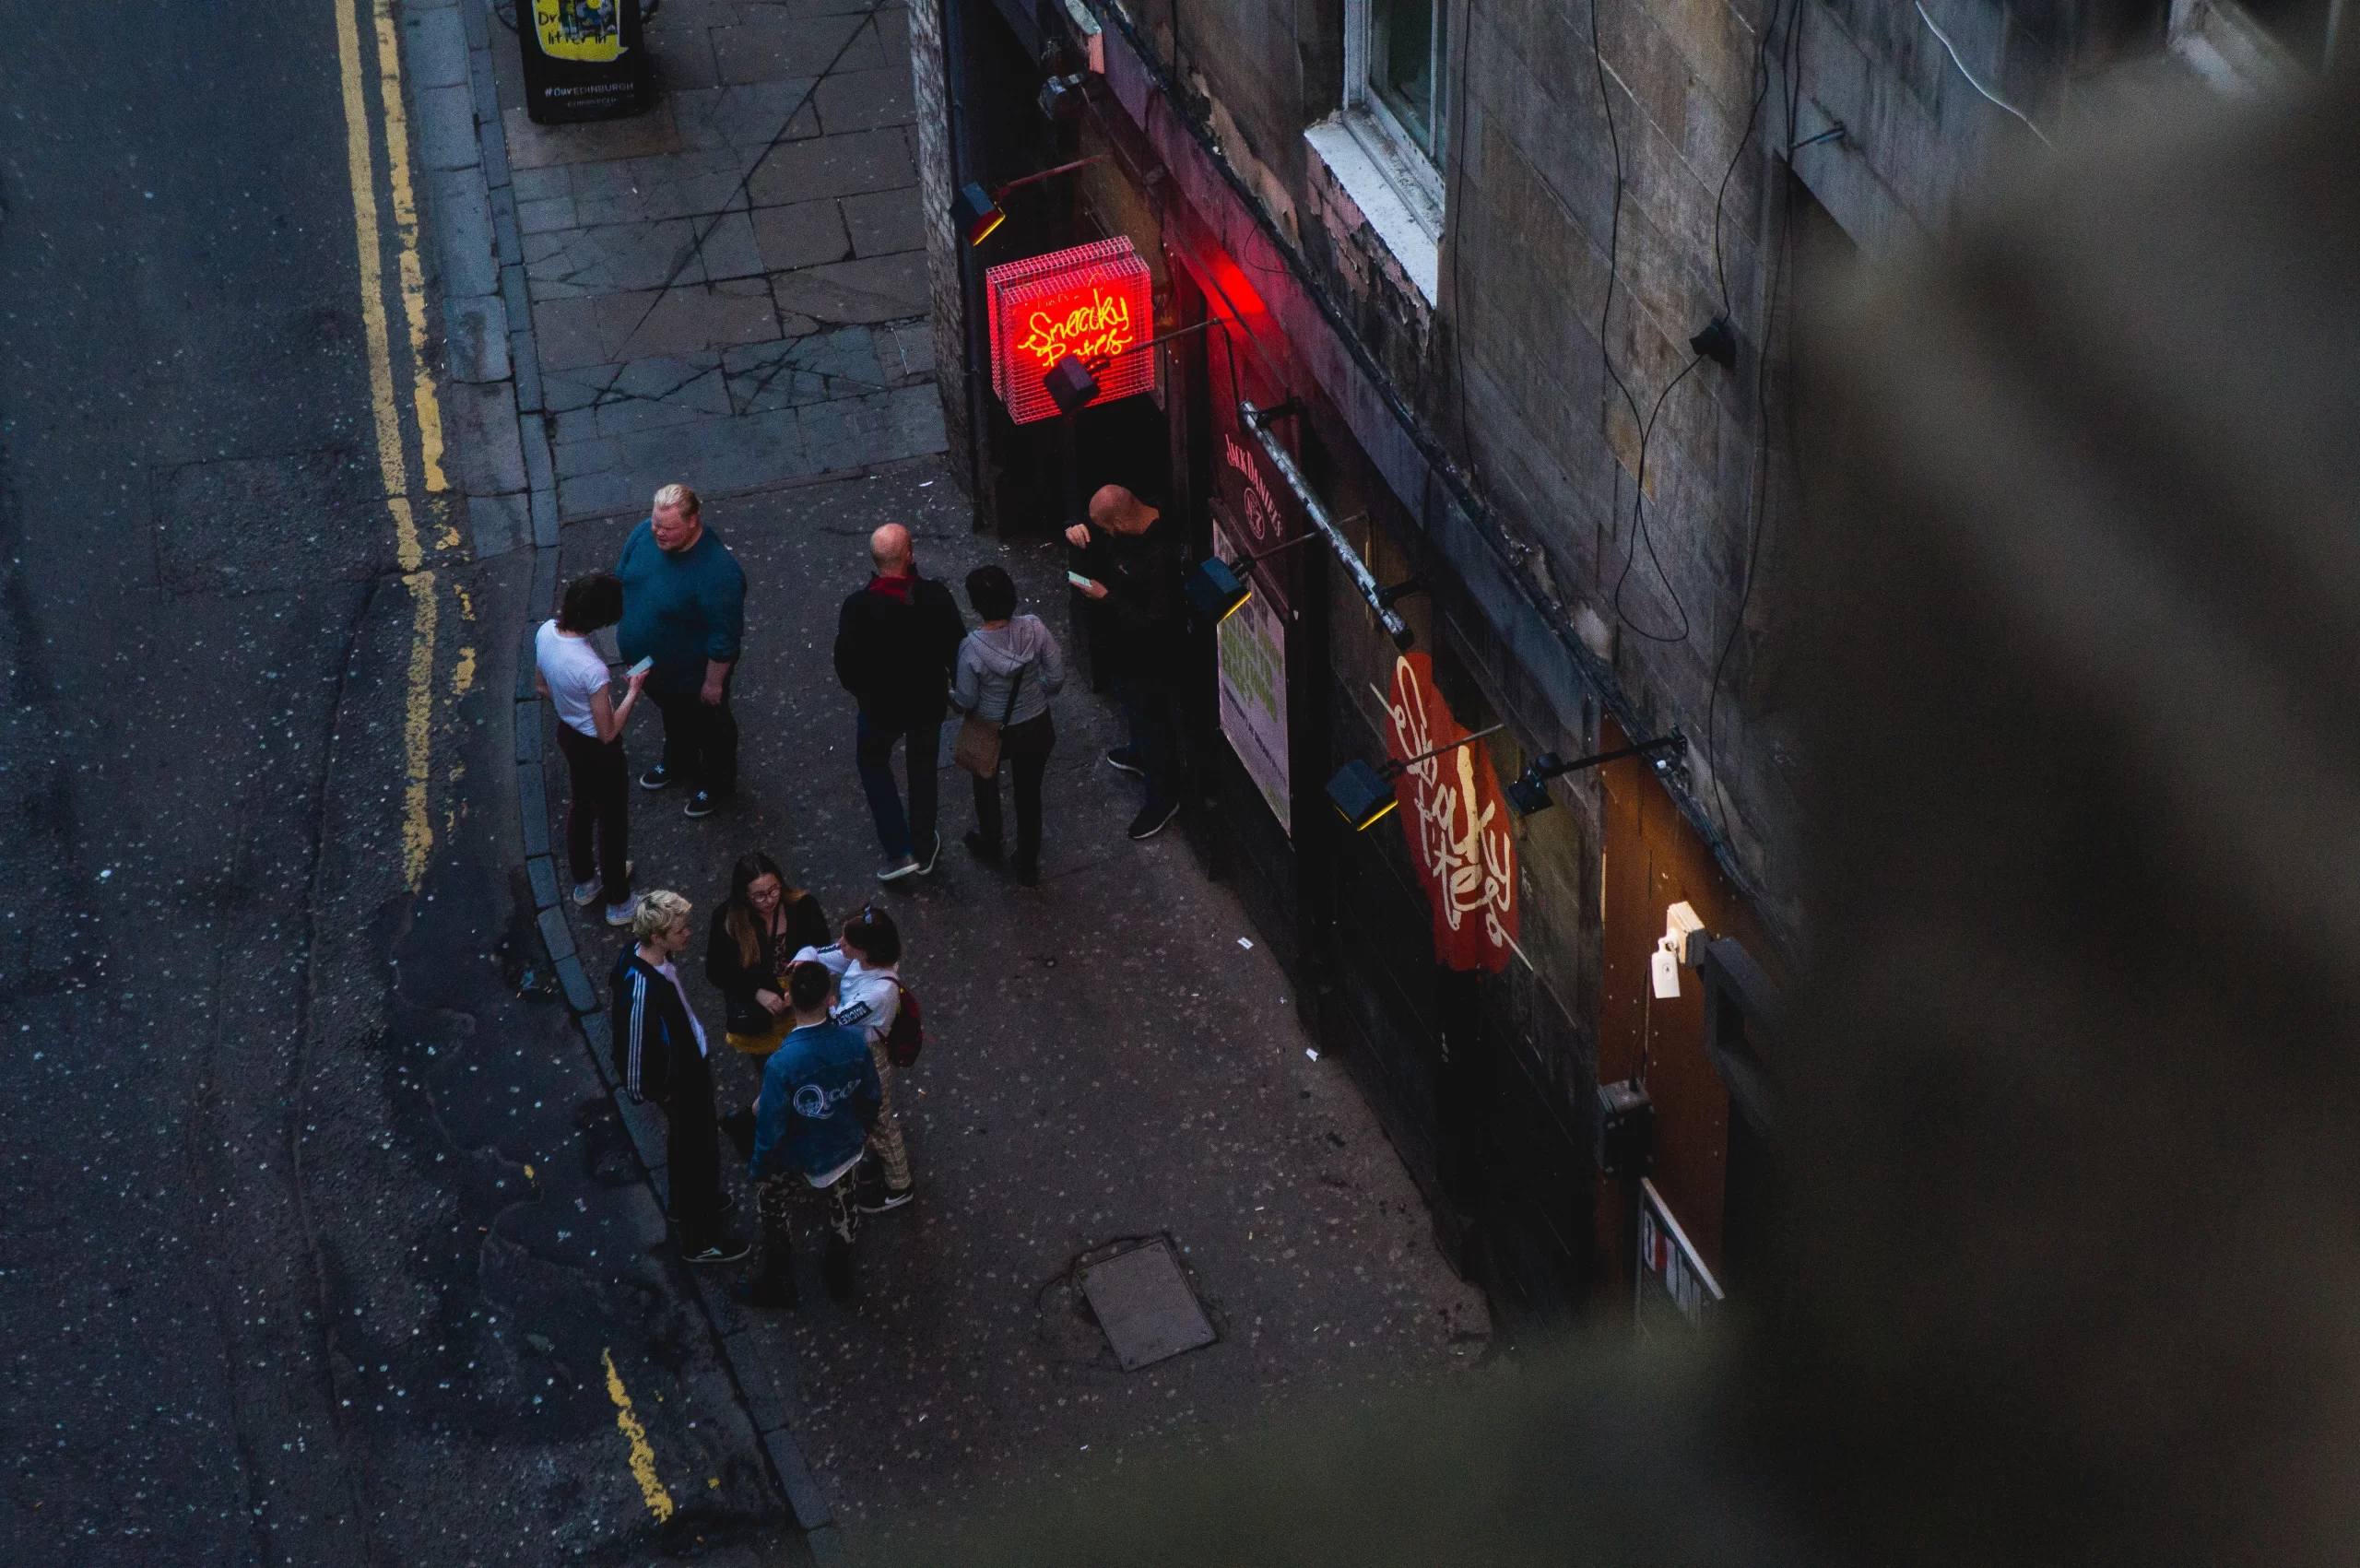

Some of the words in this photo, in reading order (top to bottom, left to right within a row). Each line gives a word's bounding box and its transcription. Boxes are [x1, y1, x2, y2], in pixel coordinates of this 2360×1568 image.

[544, 82, 634, 98] #OurEDINBURGH
[1018, 289, 1129, 351] Sneaky
[1224, 433, 1247, 476] JACK
